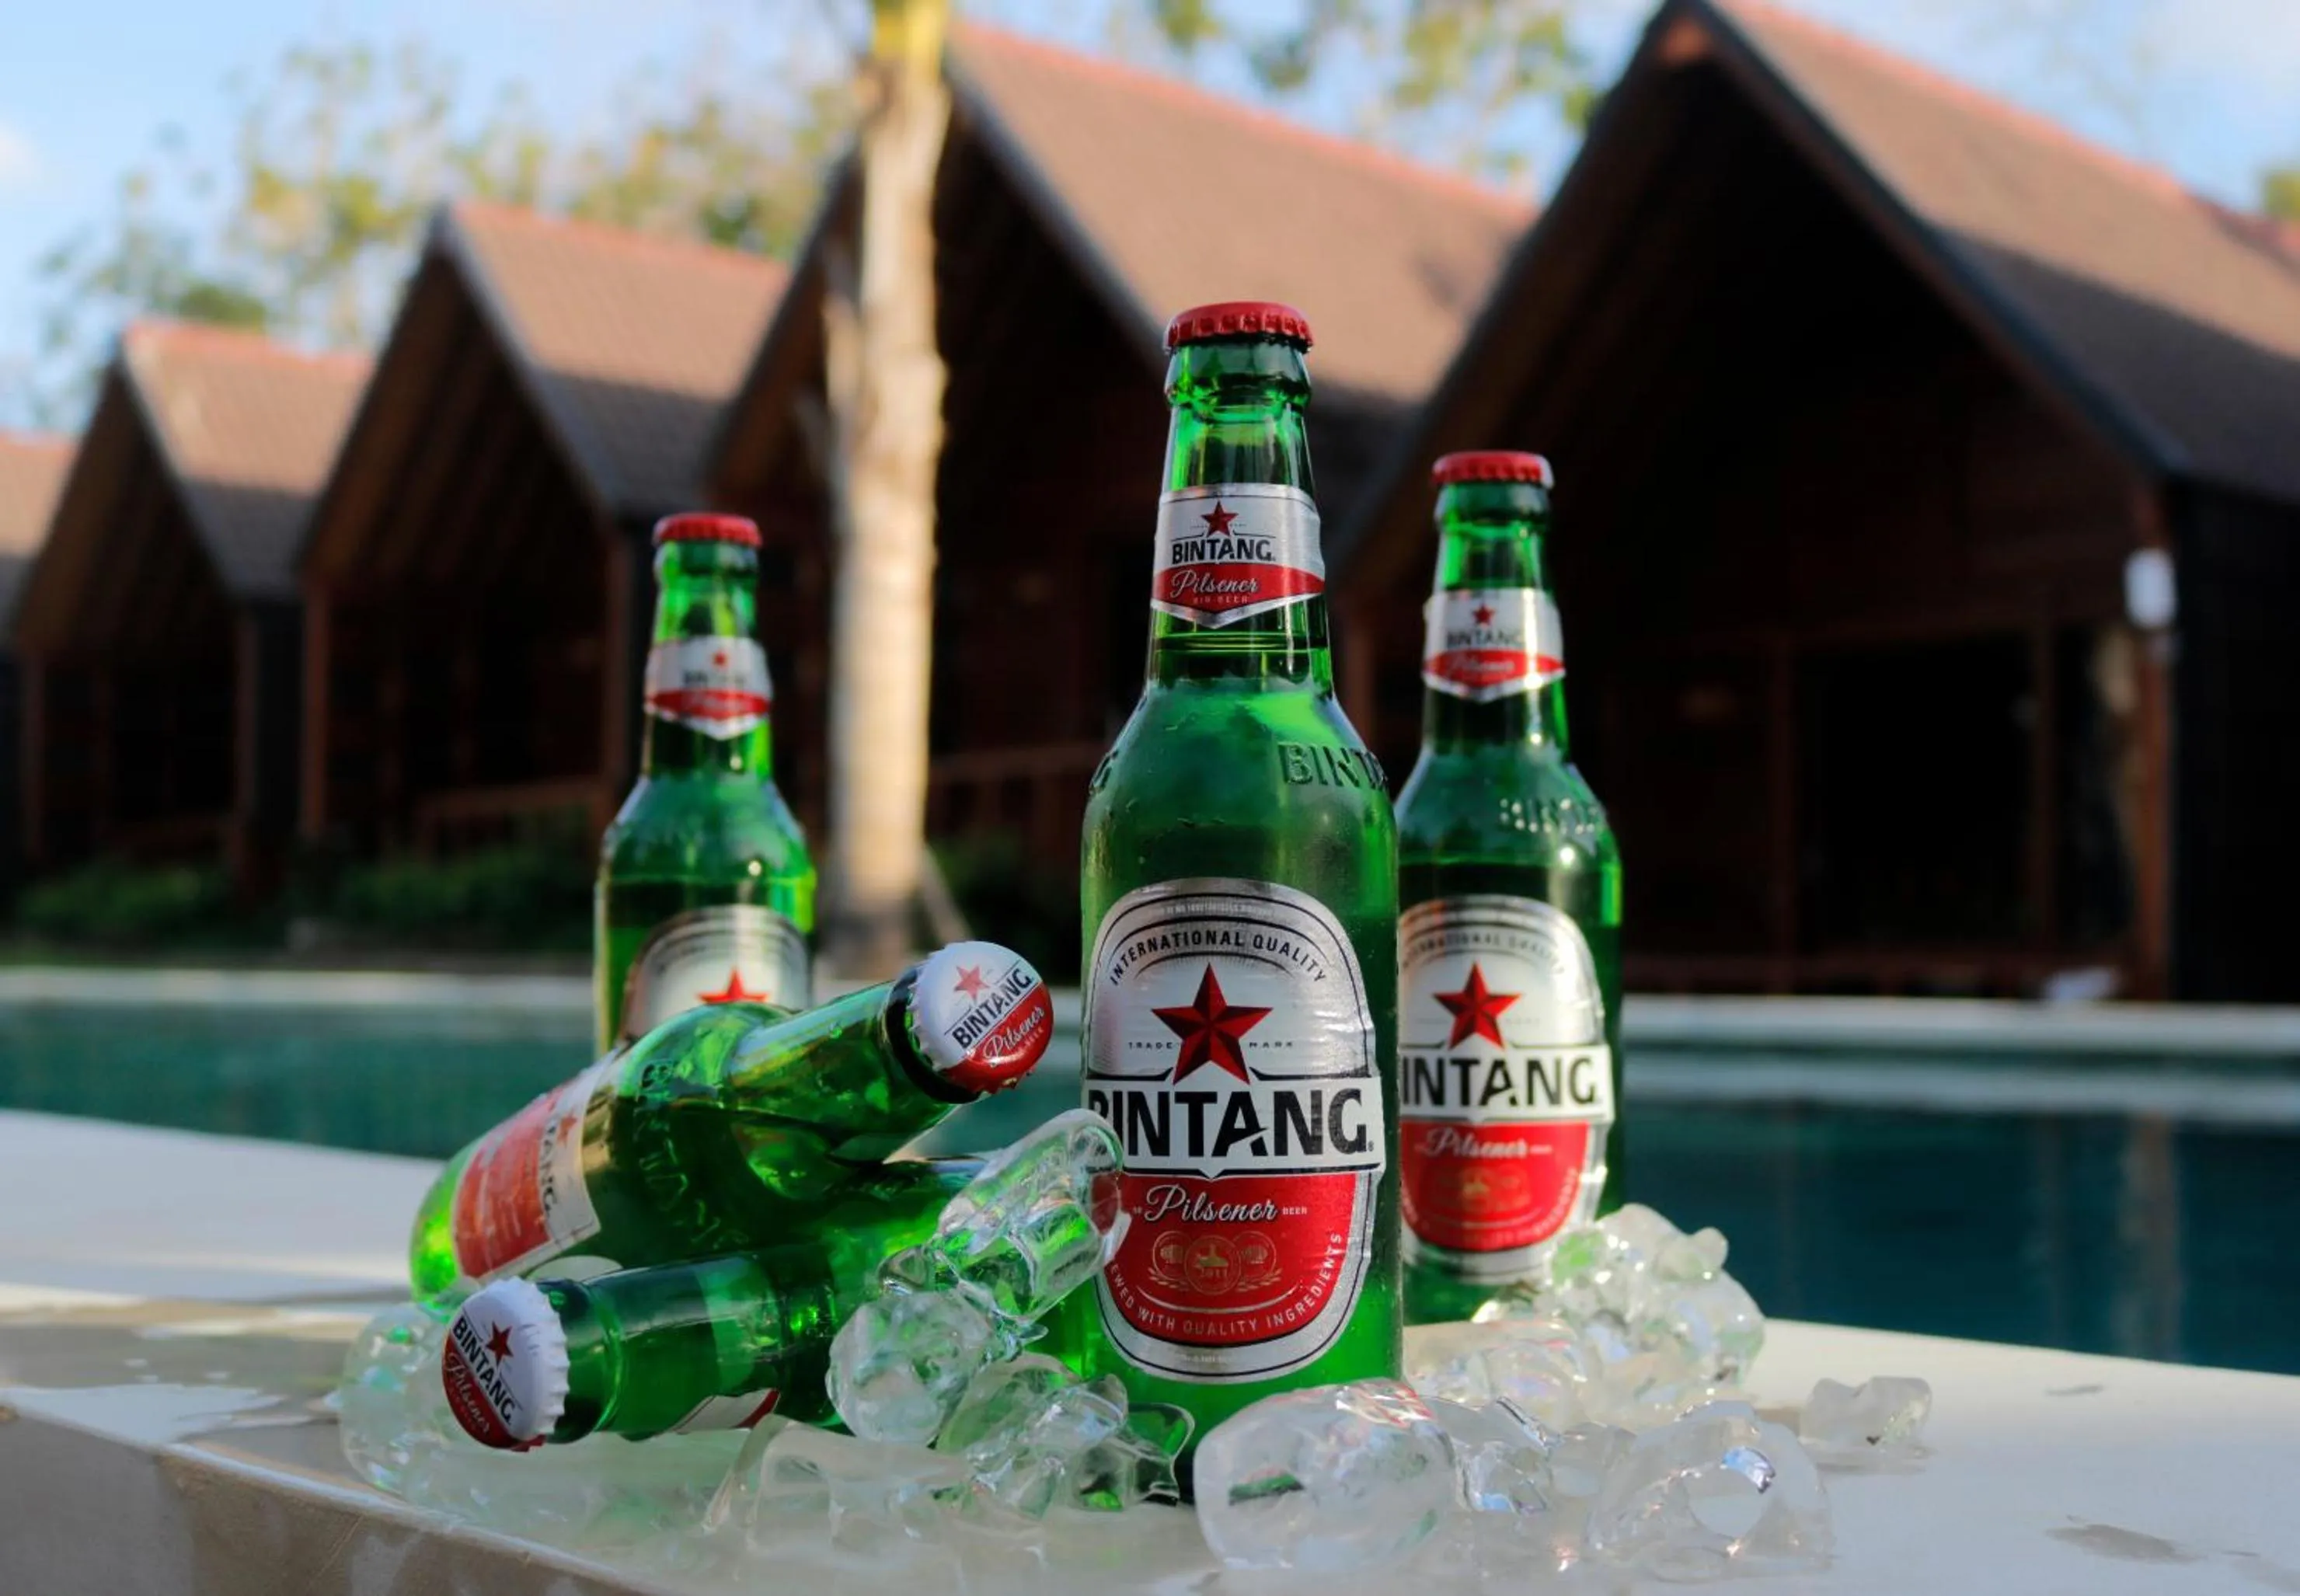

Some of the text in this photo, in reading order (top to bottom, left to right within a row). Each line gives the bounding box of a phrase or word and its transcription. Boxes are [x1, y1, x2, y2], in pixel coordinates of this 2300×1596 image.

[1172, 539, 1272, 565] BINTANG
[1169, 569, 1259, 598] Pilsener
[1110, 930, 1327, 986] INTERNATIONAL QUALITY
[951, 968, 1033, 1049] BINTANG
[982, 1005, 1045, 1062] Pilsener
[1127, 1041, 1173, 1050] TRADE
[1401, 1056, 1596, 1107] INTANG
[1144, 1183, 1277, 1221] Pilsener
[1110, 1233, 1343, 1336] EWED WITH QUALITY INGREDIENTS
[452, 1316, 513, 1427] BINTANG
